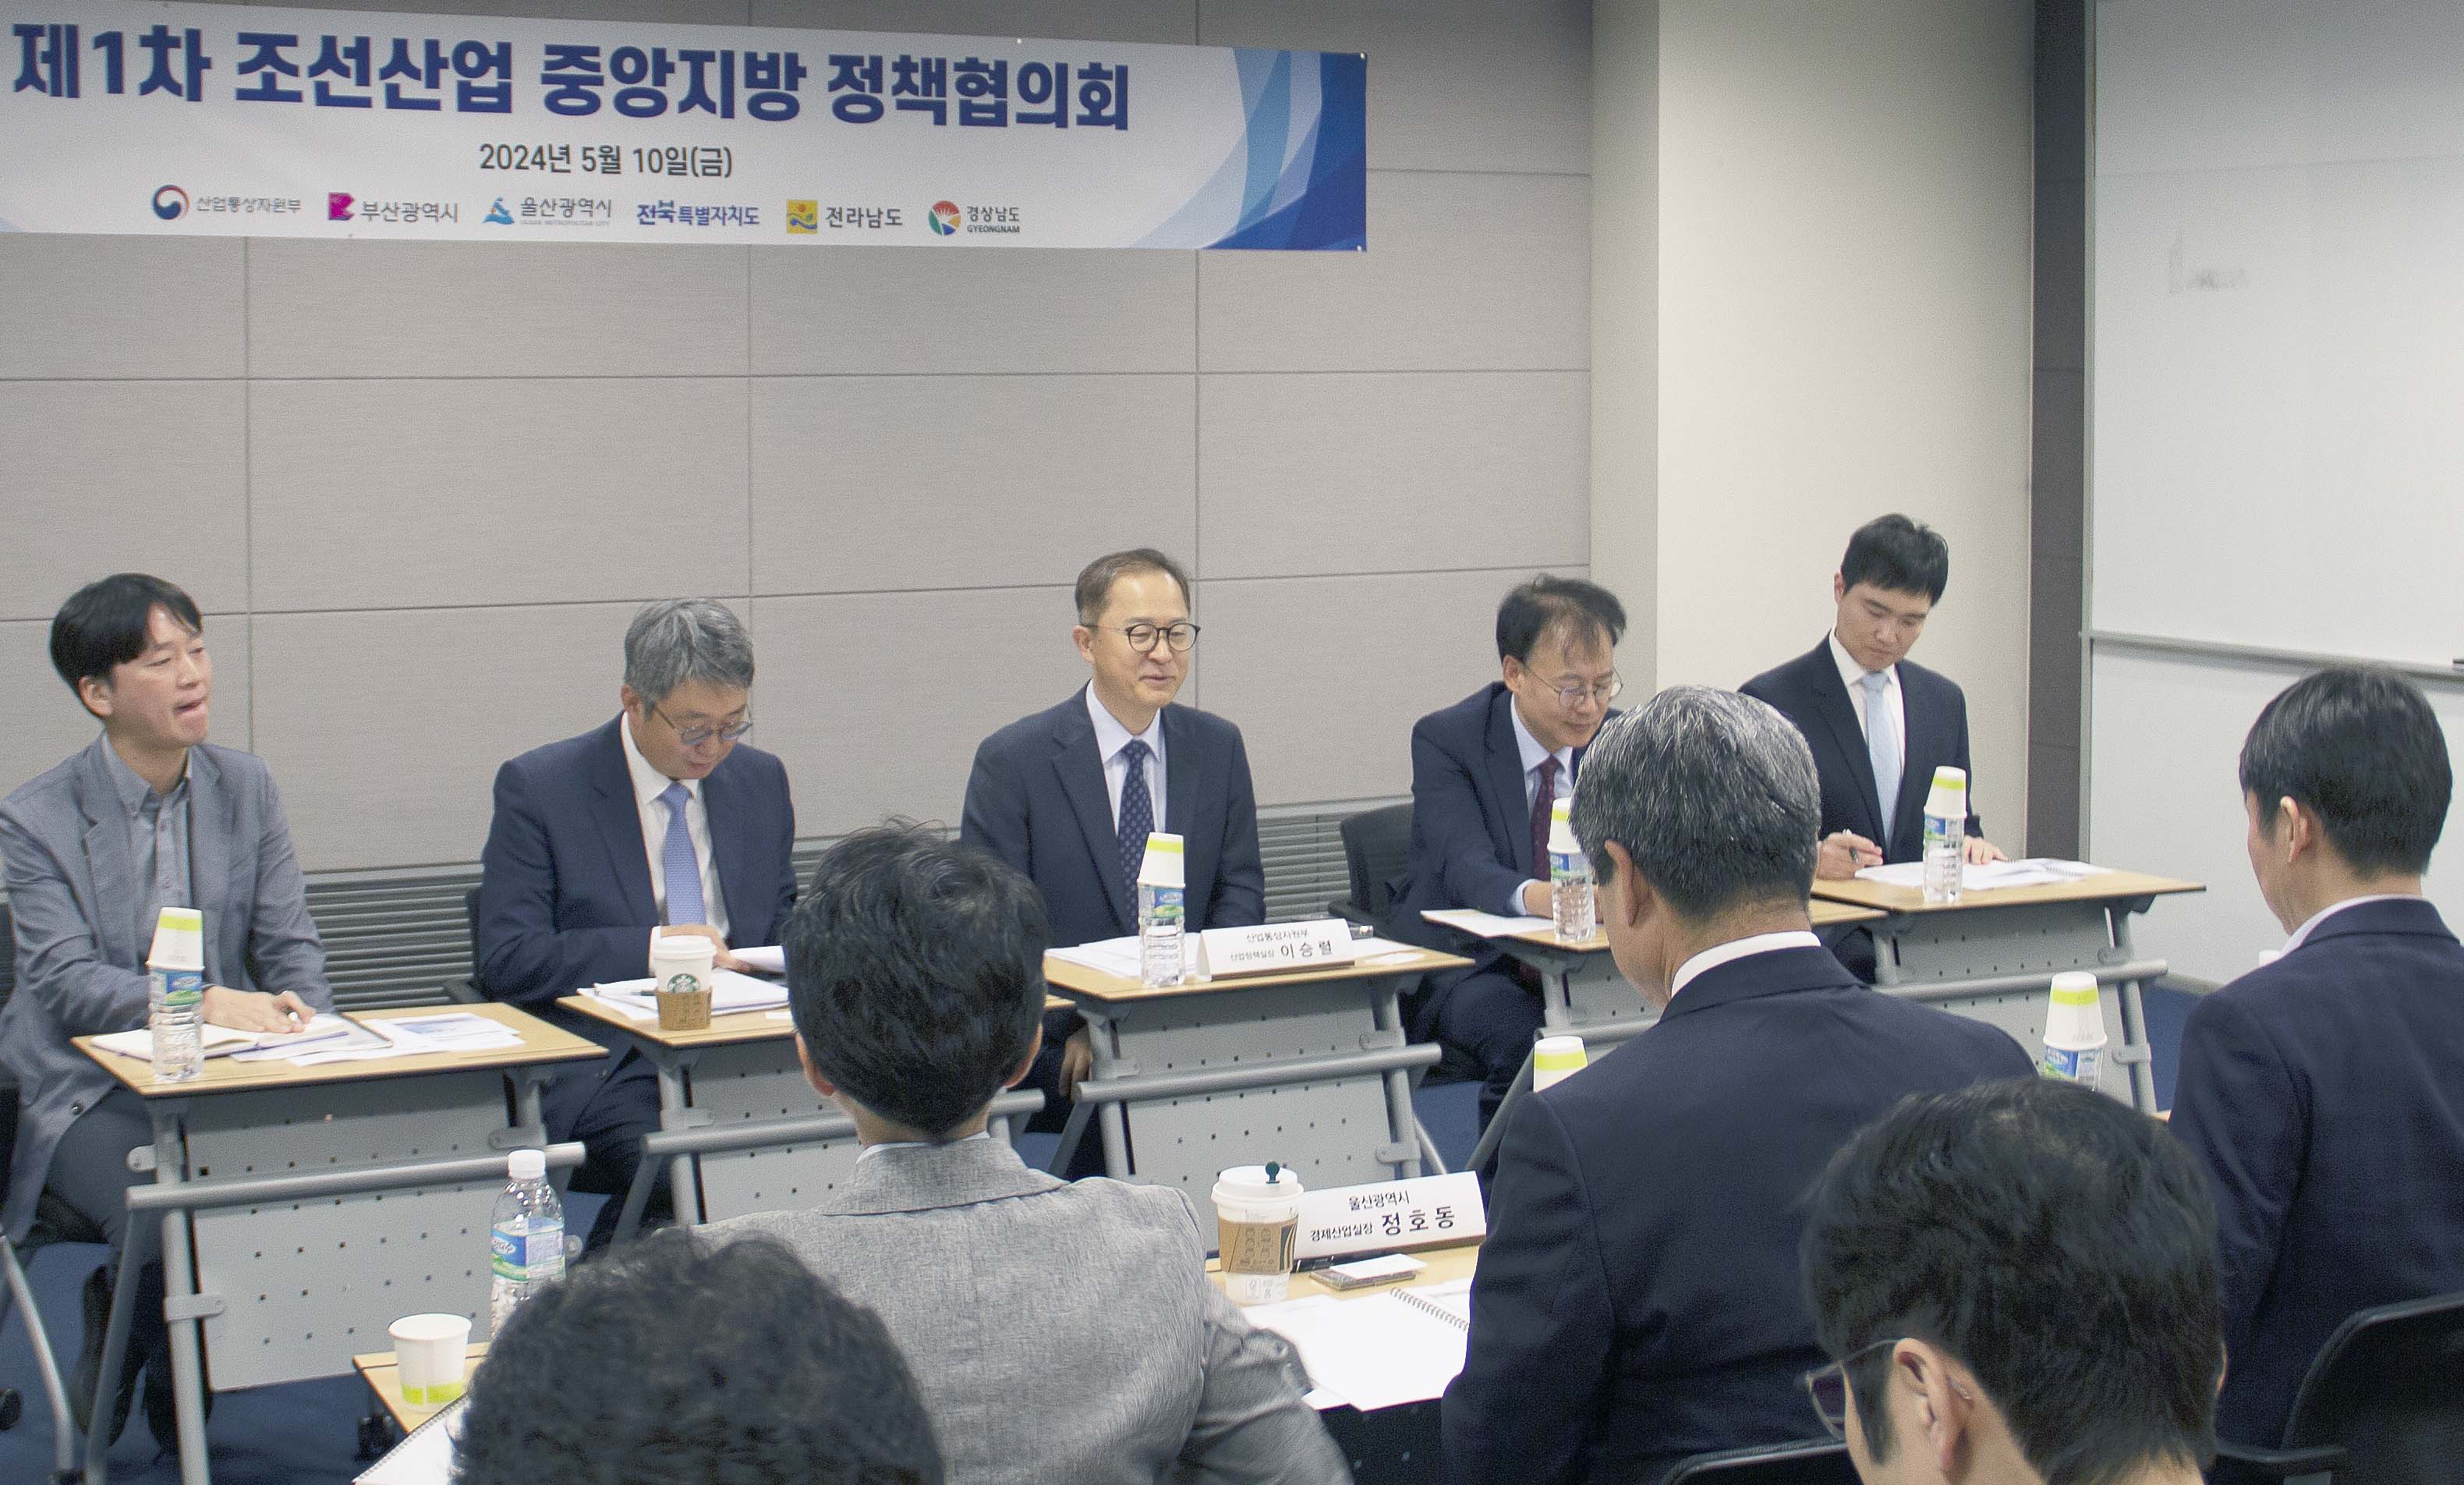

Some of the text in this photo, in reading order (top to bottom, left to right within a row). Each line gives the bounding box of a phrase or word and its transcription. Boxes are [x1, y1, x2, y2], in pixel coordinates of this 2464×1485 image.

[12, 23, 1129, 130] 제1차 조선산업 중앙지방 정책협의회
[480, 143, 732, 178] 2024년 5월 10일(금)
[361, 200, 458, 223] 부산광역시
[521, 197, 612, 218] 울산광역시
[636, 200, 760, 226] 전북특별자치도
[826, 207, 903, 229] 전라남도
[967, 206, 1020, 222] 경상남도
[967, 225, 1020, 234] GYEONGNAM
[1349, 1189, 1410, 1211] 울산광역시
